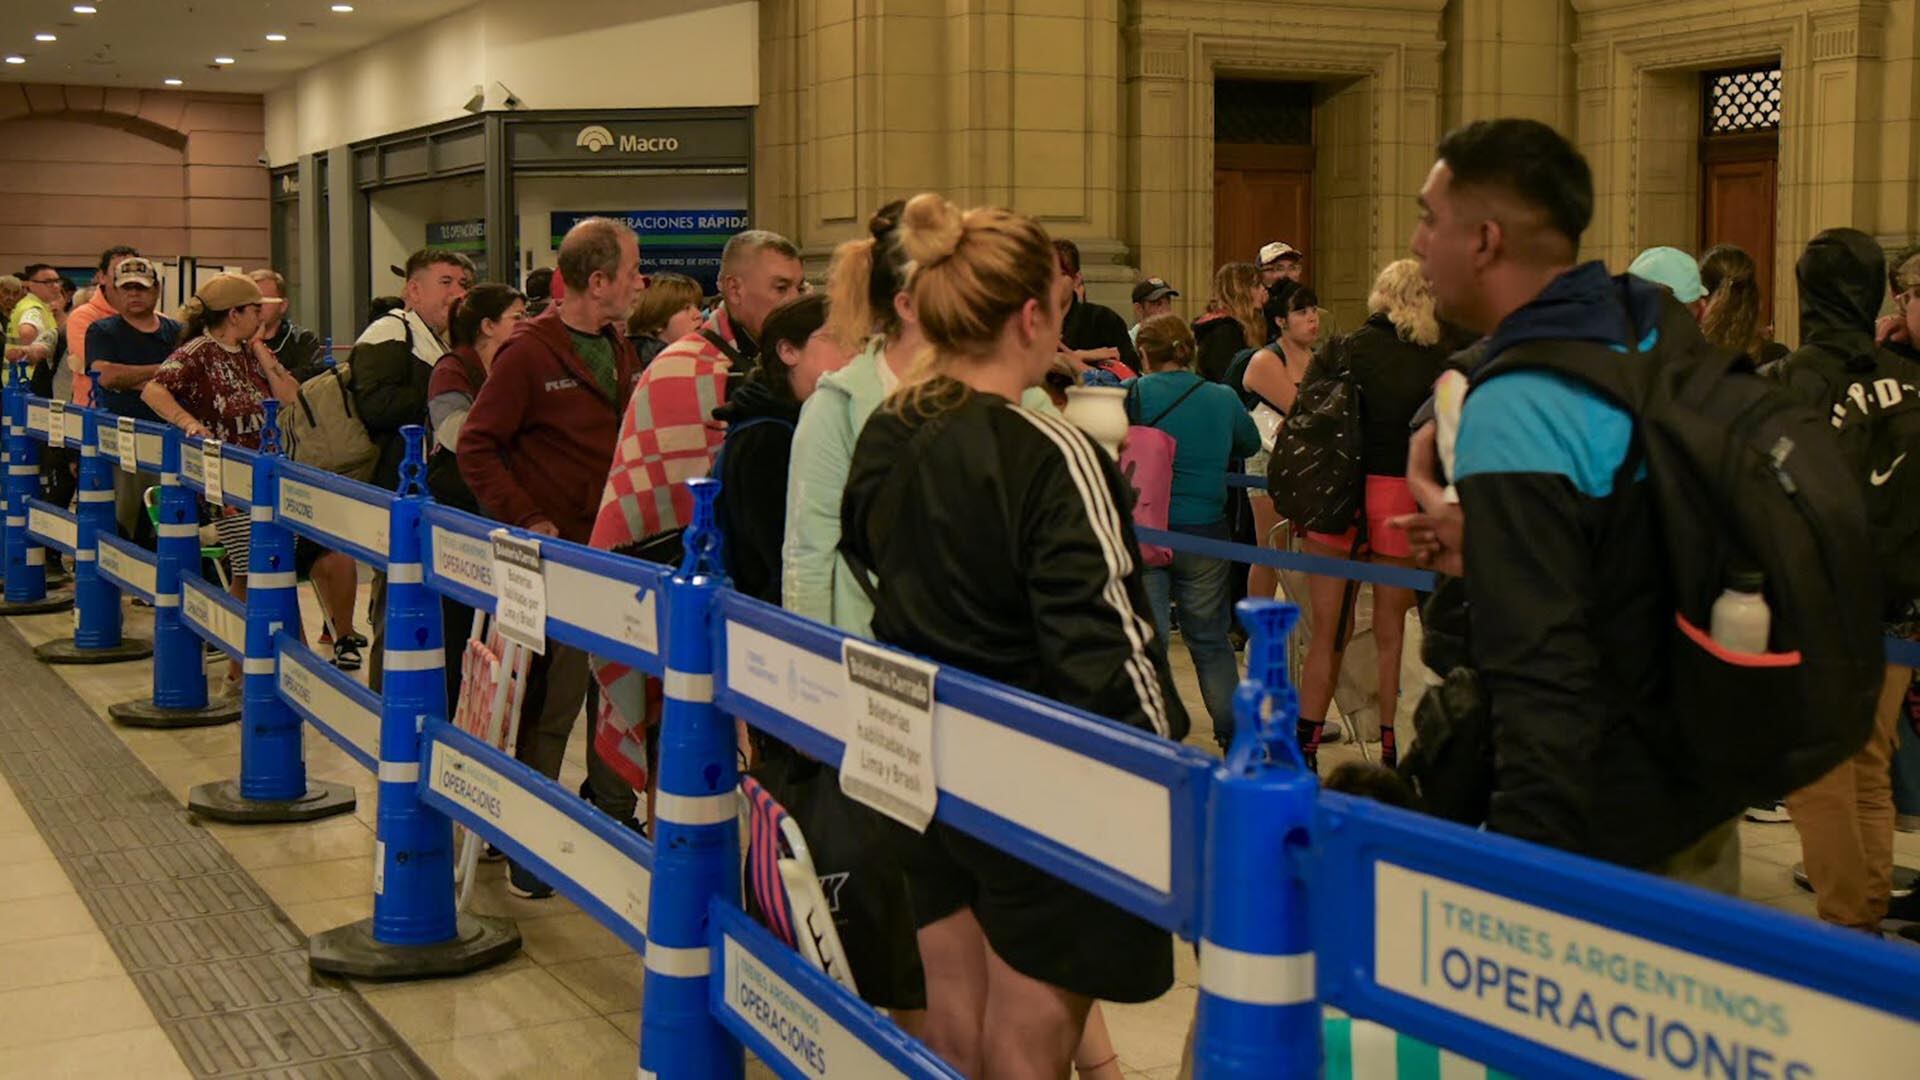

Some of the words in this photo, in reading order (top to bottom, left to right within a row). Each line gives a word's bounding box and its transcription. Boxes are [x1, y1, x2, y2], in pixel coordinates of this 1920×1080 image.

[619, 135, 679, 152] Macro
[443, 770, 501, 819] OPERACIONES
[1440, 900, 1555, 959] TRENES
[1563, 941, 1791, 1038] ARGENTINOS
[740, 982, 826, 1075] OPERACIONES
